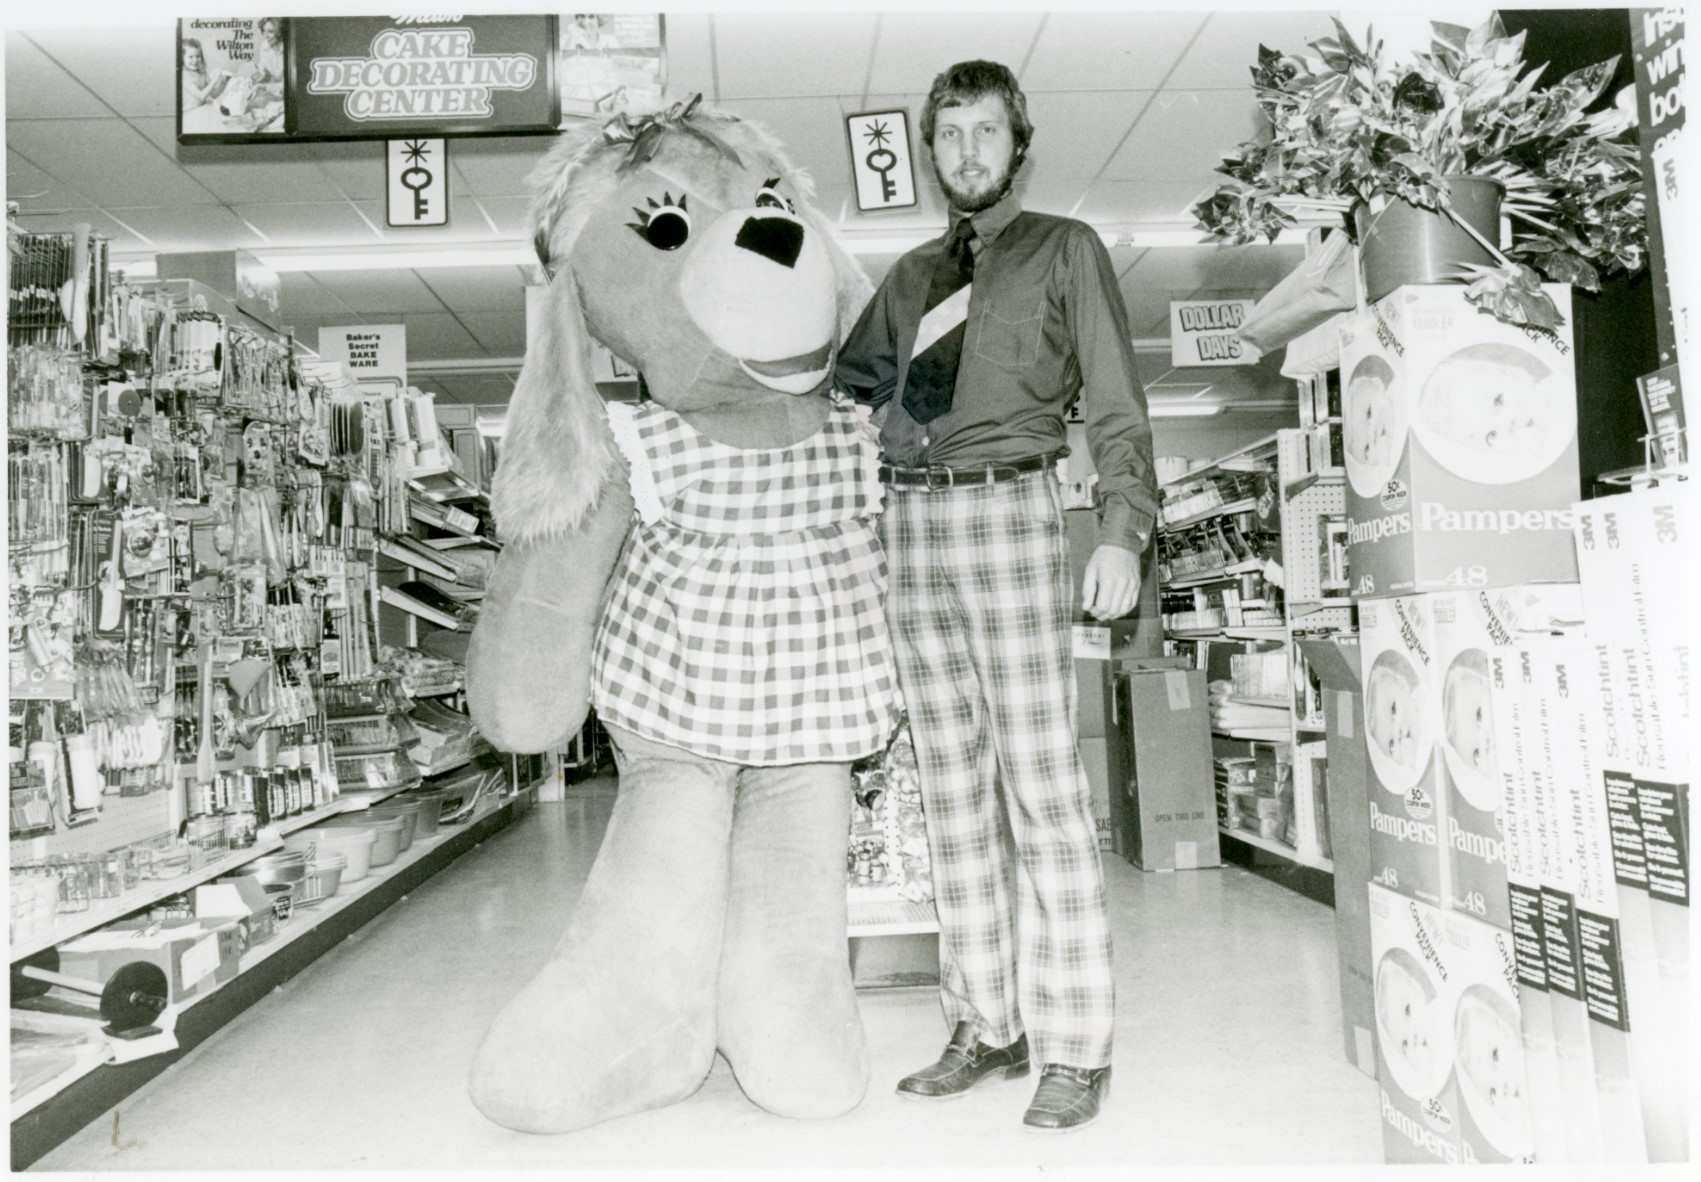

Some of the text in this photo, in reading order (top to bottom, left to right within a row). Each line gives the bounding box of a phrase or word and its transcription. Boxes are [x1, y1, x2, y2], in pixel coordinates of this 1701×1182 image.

[191, 18, 252, 30] decorating
[233, 29, 254, 40] The
[216, 40, 254, 50] Wilton
[229, 50, 254, 61] Way
[374, 32, 469, 60] CAKE
[314, 57, 532, 89] DECORATING
[349, 86, 489, 116] CENTER
[1663, 159, 1678, 201] 3M
[1179, 303, 1246, 333] DOLLAR
[346, 333, 381, 341] Baker's
[348, 342, 379, 350] Secret
[1197, 334, 1243, 361] DAYS
[349, 360, 378, 368] WARE
[350, 351, 377, 359] BAKE
[1348, 512, 1411, 545] Pampers
[1420, 502, 1576, 534] Pampers
[1580, 514, 1595, 550] 3M
[1604, 512, 1620, 550] 3M
[1652, 505, 1678, 544] 3M
[1359, 574, 1375, 595] 48
[1445, 565, 1488, 586] 48
[1395, 599, 1430, 666] CONVENIENCE
[1400, 626, 1415, 651] PACK
[1486, 622, 1504, 647] PAC
[1633, 597, 1652, 657] Control
[1492, 657, 1505, 690] 3M
[1520, 651, 1532, 684] 3M
[1556, 664, 1569, 699] 3M
[1595, 644, 1620, 759] Scotchtint
[1622, 647, 1651, 768] Scotchtint
[1154, 814, 1172, 822] OPEN
[1175, 812, 1190, 821] THIS
[1370, 801, 1437, 846] Pampers
[1503, 772, 1522, 874] Scotchtint
[1532, 770, 1551, 876] Scotchtint
[1570, 788, 1591, 900] Scotchtint
[1380, 866, 1398, 888] 48
[1464, 890, 1486, 915] 48
[1409, 901, 1449, 983] CONVENIENCE
[1415, 932, 1433, 963] PACK
[1382, 1089, 1458, 1163] Pampers
